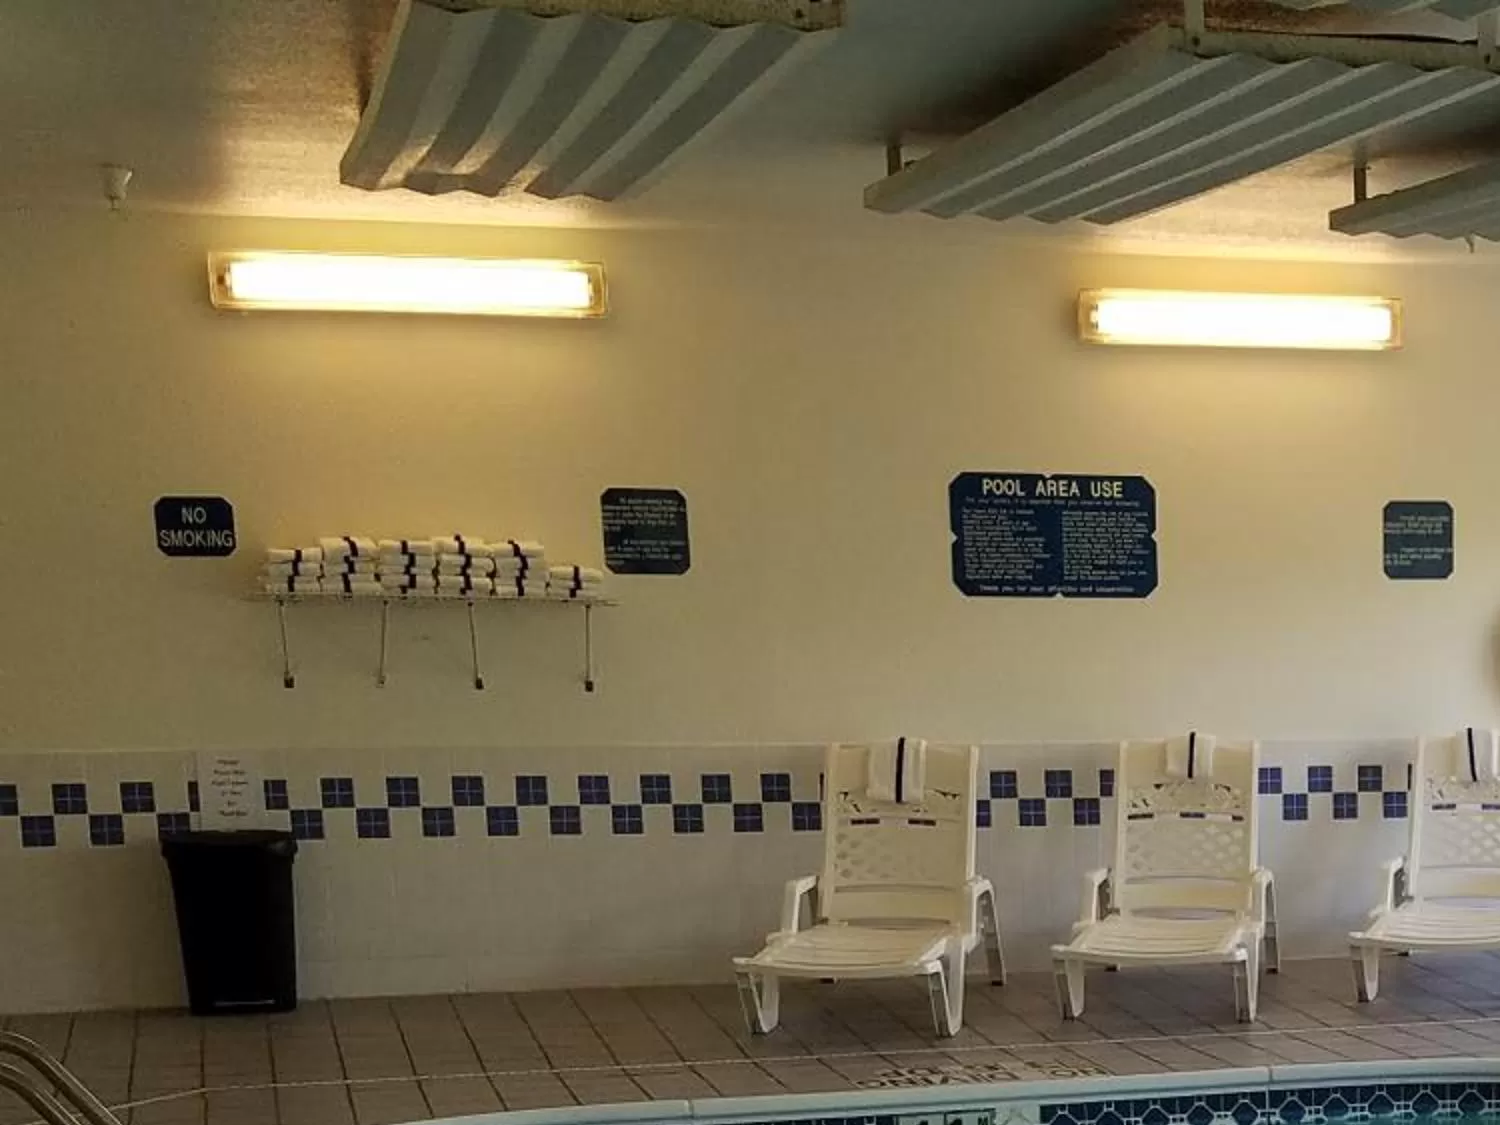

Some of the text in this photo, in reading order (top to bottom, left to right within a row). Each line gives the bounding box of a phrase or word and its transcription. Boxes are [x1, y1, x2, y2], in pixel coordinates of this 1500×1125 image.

[982, 478, 1124, 498] POOL AREA USE
[181, 506, 207, 524] NO
[160, 529, 233, 548] SMOKING
